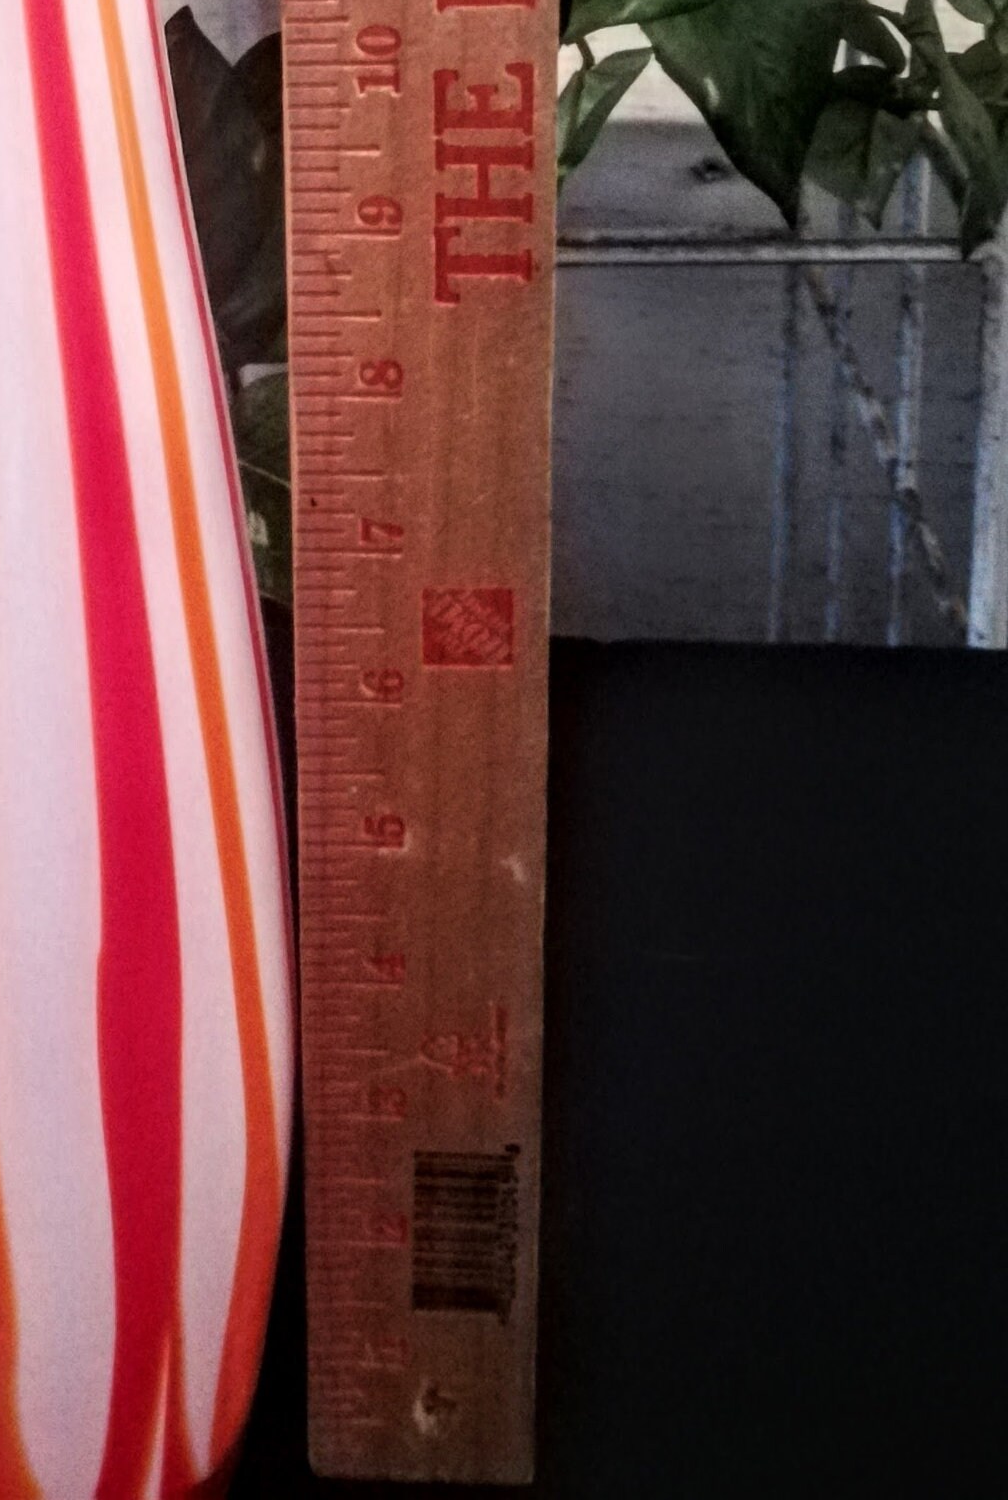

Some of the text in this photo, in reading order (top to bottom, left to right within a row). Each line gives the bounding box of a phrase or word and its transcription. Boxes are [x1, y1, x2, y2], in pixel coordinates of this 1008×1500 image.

[356, 24, 401, 95] 10
[434, 63, 535, 306] THE
[358, 195, 403, 227] 9
[359, 359, 403, 391] 8
[361, 518, 403, 546] 7
[359, 670, 405, 700] 6
[364, 814, 406, 846] 5
